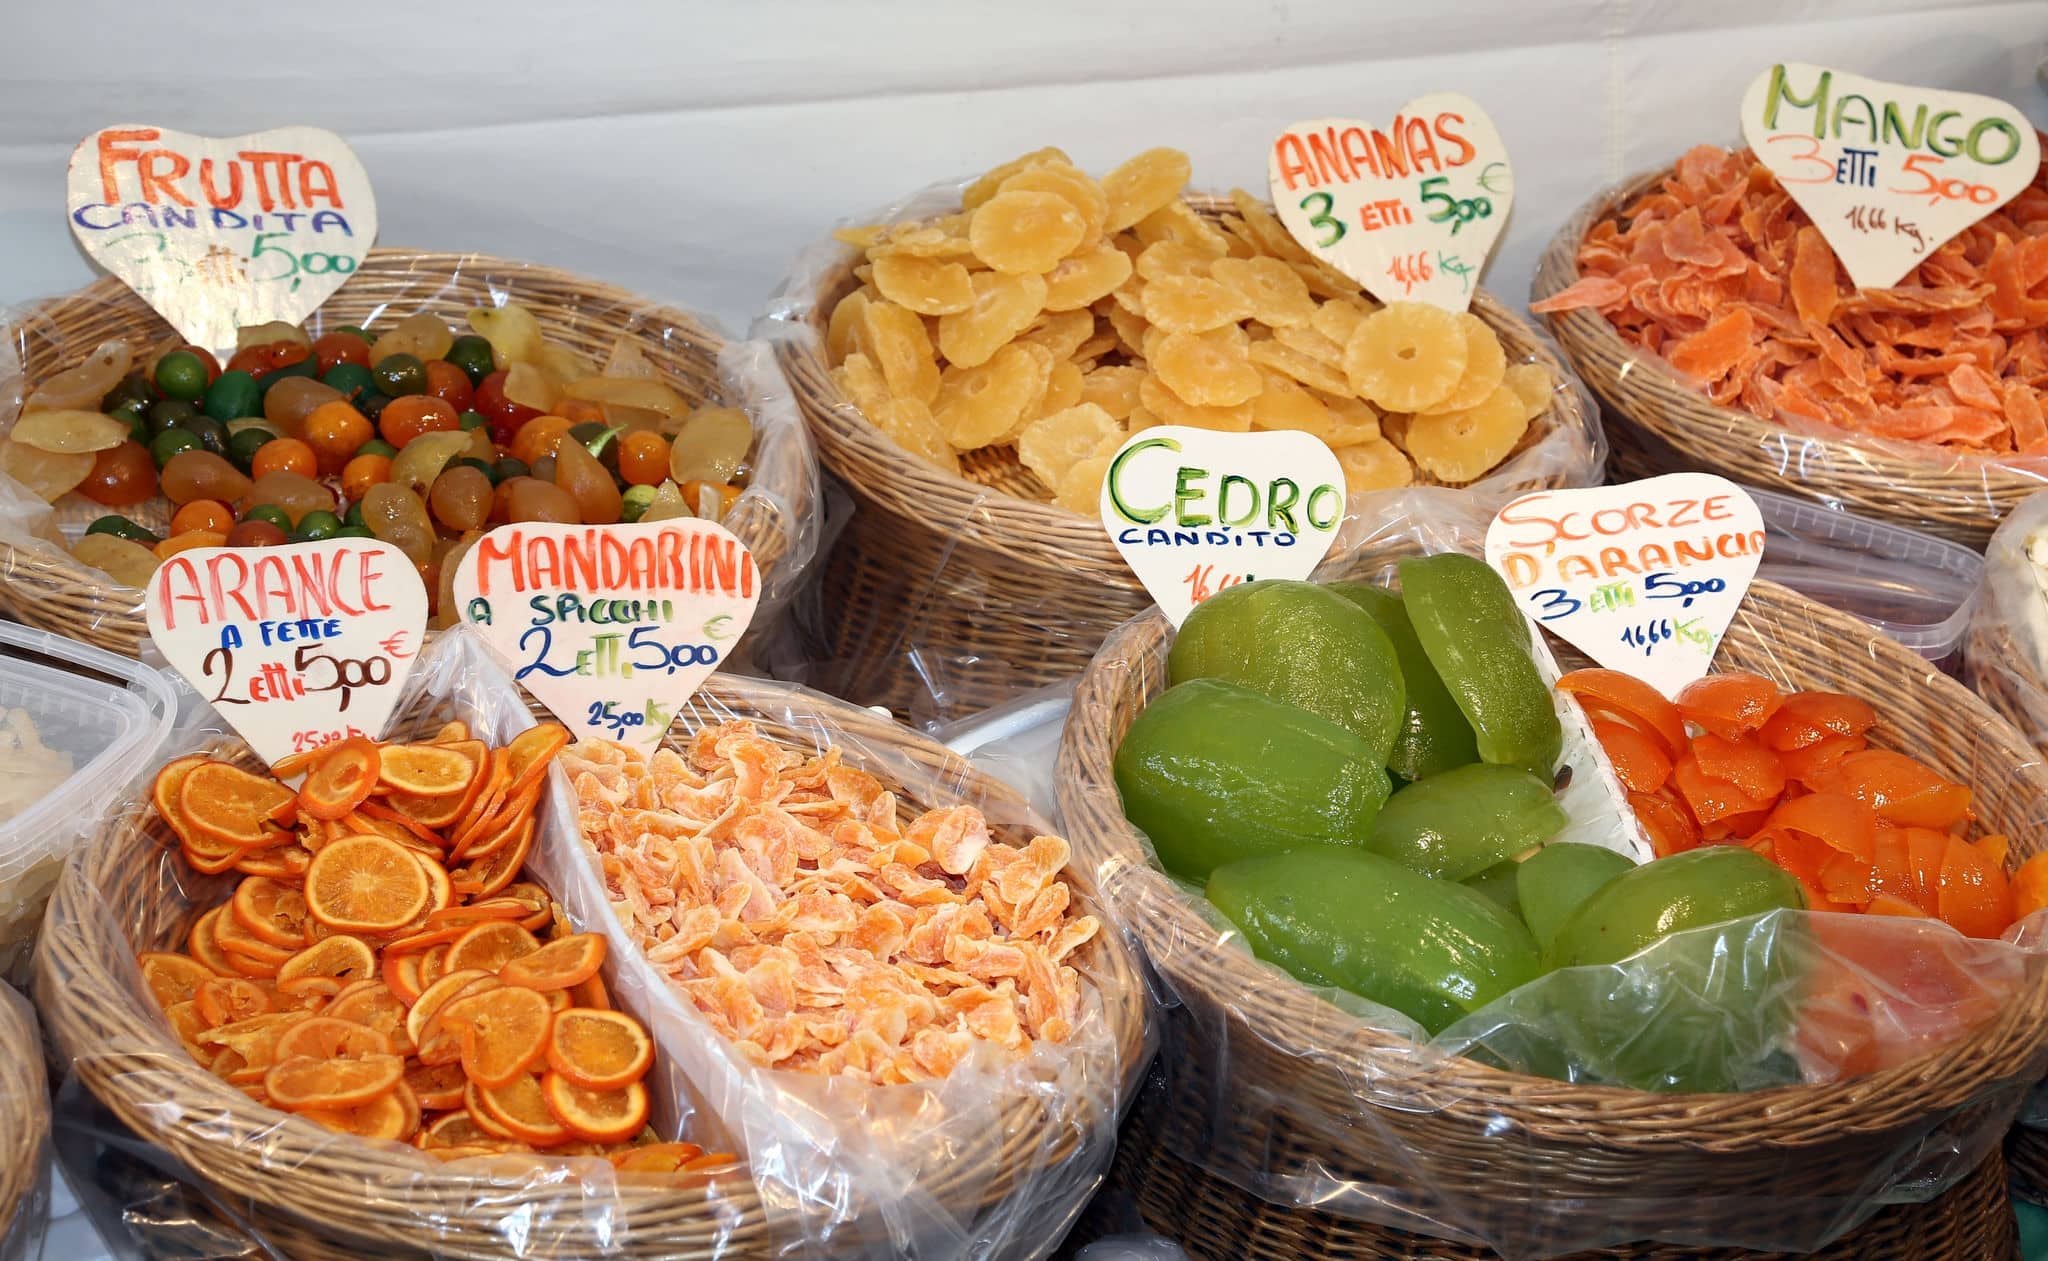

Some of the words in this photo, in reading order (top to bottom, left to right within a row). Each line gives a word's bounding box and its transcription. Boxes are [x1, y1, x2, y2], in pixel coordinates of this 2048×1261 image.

[1763, 64, 2021, 165] MANGO
[98, 129, 344, 212] FRUTTA
[1275, 112, 1476, 191] ANANAS
[1766, 134, 1837, 184] 3
[1836, 147, 1879, 188] ETTI
[1888, 154, 1998, 206] 5,00
[73, 203, 354, 237] CANDITA
[1300, 192, 1348, 249] 3
[1360, 199, 1413, 231] ETTI
[1420, 176, 1493, 236] 5,00
[1844, 204, 1887, 234] 16,66
[252, 233, 356, 293] 5,00
[1107, 437, 1343, 535] CEDRO
[1118, 526, 1296, 547] CANDITO
[1499, 495, 1735, 548] SCORZE
[159, 548, 391, 630] ARANCE
[477, 527, 753, 599] MANDARINI
[467, 597, 492, 626] A
[1530, 589, 1581, 620] 3
[1645, 572, 1726, 608] 5,00
[221, 624, 243, 650] A
[259, 618, 343, 646] FETTE
[515, 626, 580, 680] 2
[628, 625, 718, 676] 5,00
[1621, 619, 1672, 656] 16,66
[202, 647, 252, 705] 2
[295, 643, 392, 712] 5,00
[587, 700, 644, 741] 25,00
